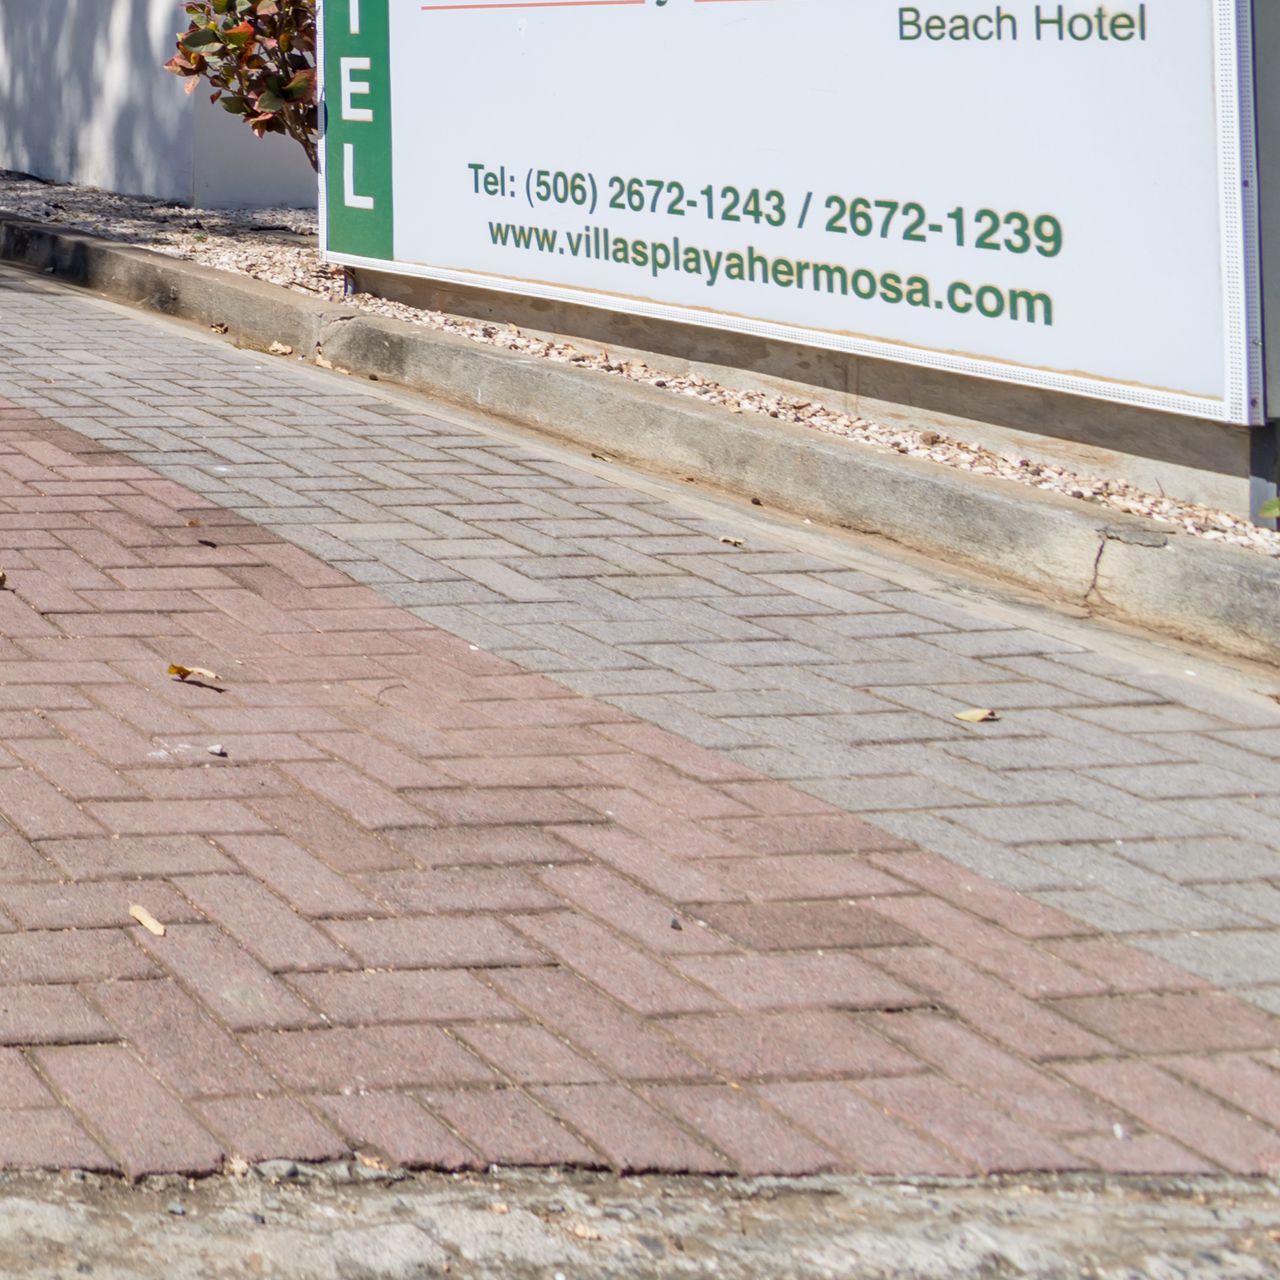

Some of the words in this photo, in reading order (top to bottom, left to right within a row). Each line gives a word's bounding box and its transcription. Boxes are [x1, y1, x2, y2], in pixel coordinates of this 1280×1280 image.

[898, 5, 1018, 41] Beach
[1035, 3, 1147, 41] Hotel
[468, 163, 516, 198] Tel:
[525, 167, 598, 215] (506)
[608, 176, 787, 227] 2672-1243
[797, 191, 813, 229] /
[824, 195, 1063, 258] 2672-1239
[488, 221, 1053, 326] www.villasplayahermosa.com
